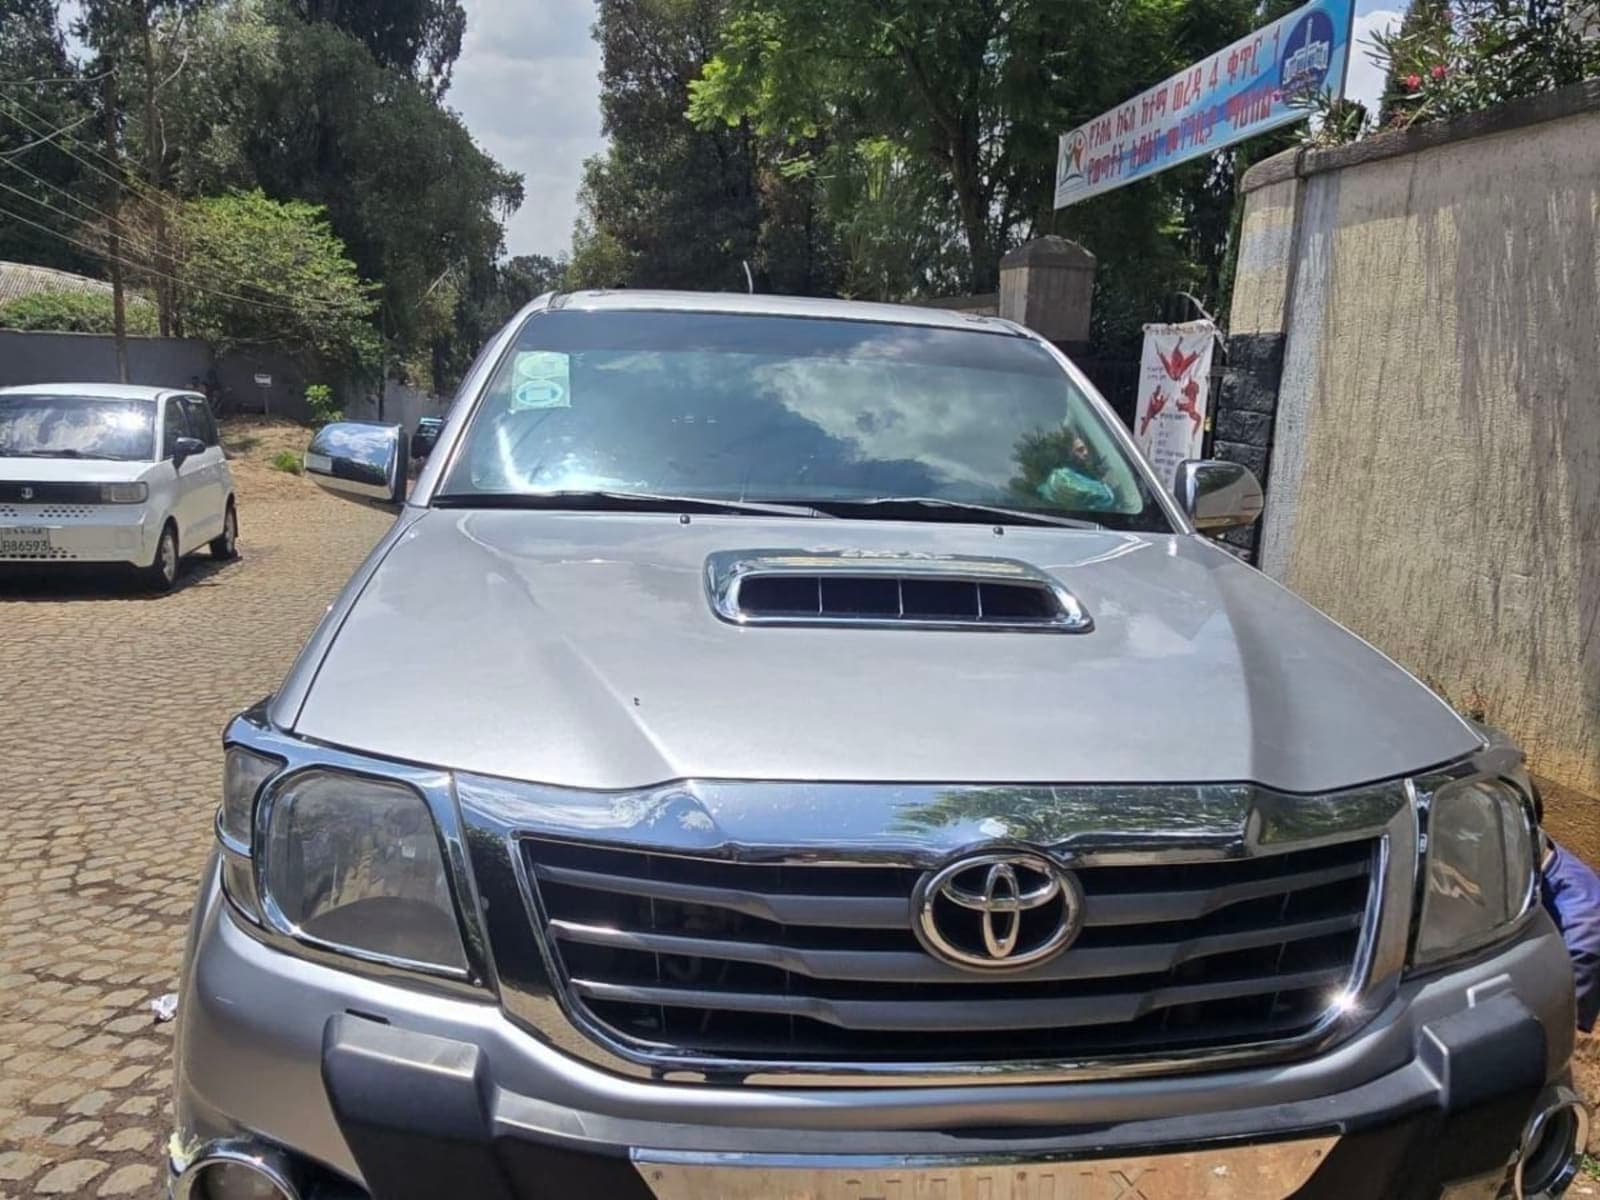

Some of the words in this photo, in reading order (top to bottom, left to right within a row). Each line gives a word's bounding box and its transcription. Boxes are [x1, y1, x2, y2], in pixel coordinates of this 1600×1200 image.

[1141, 88, 1168, 126] ከተማ
[1172, 67, 1202, 111] ወረዳ
[1227, 35, 1263, 85] ቁጥር
